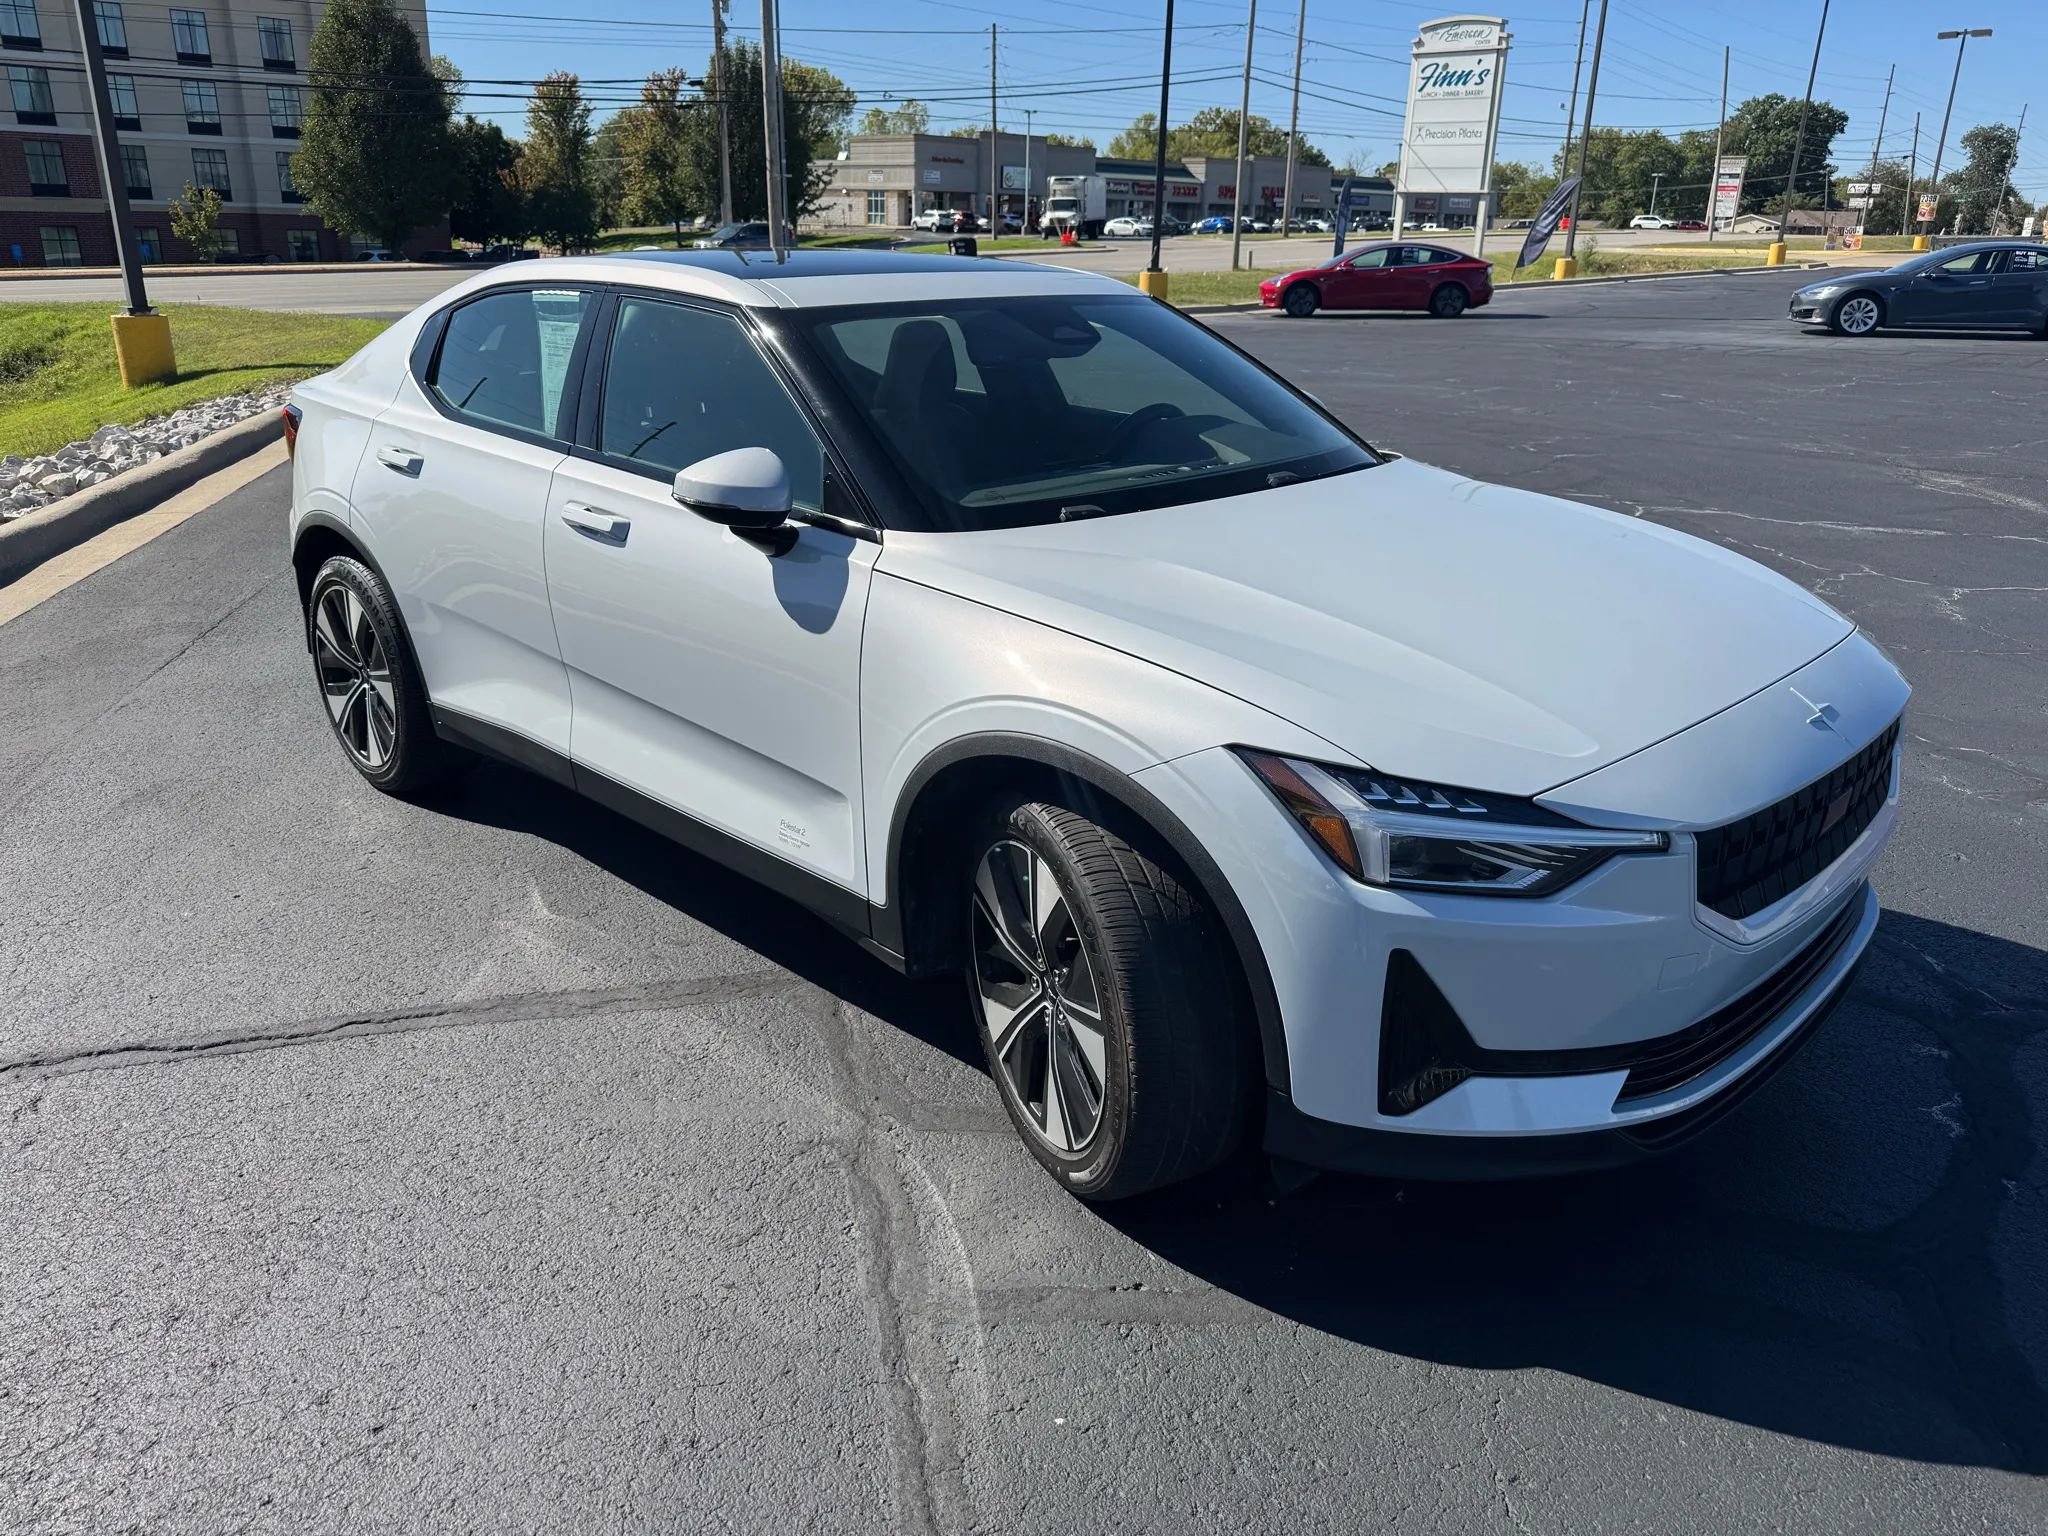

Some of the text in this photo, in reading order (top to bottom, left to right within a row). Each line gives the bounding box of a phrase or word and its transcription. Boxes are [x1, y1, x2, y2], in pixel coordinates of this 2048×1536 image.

[1418, 58, 1491, 93] Finn's
[1464, 89, 1485, 97] BAKERY
[1425, 127, 1483, 139] Precision Pilates
